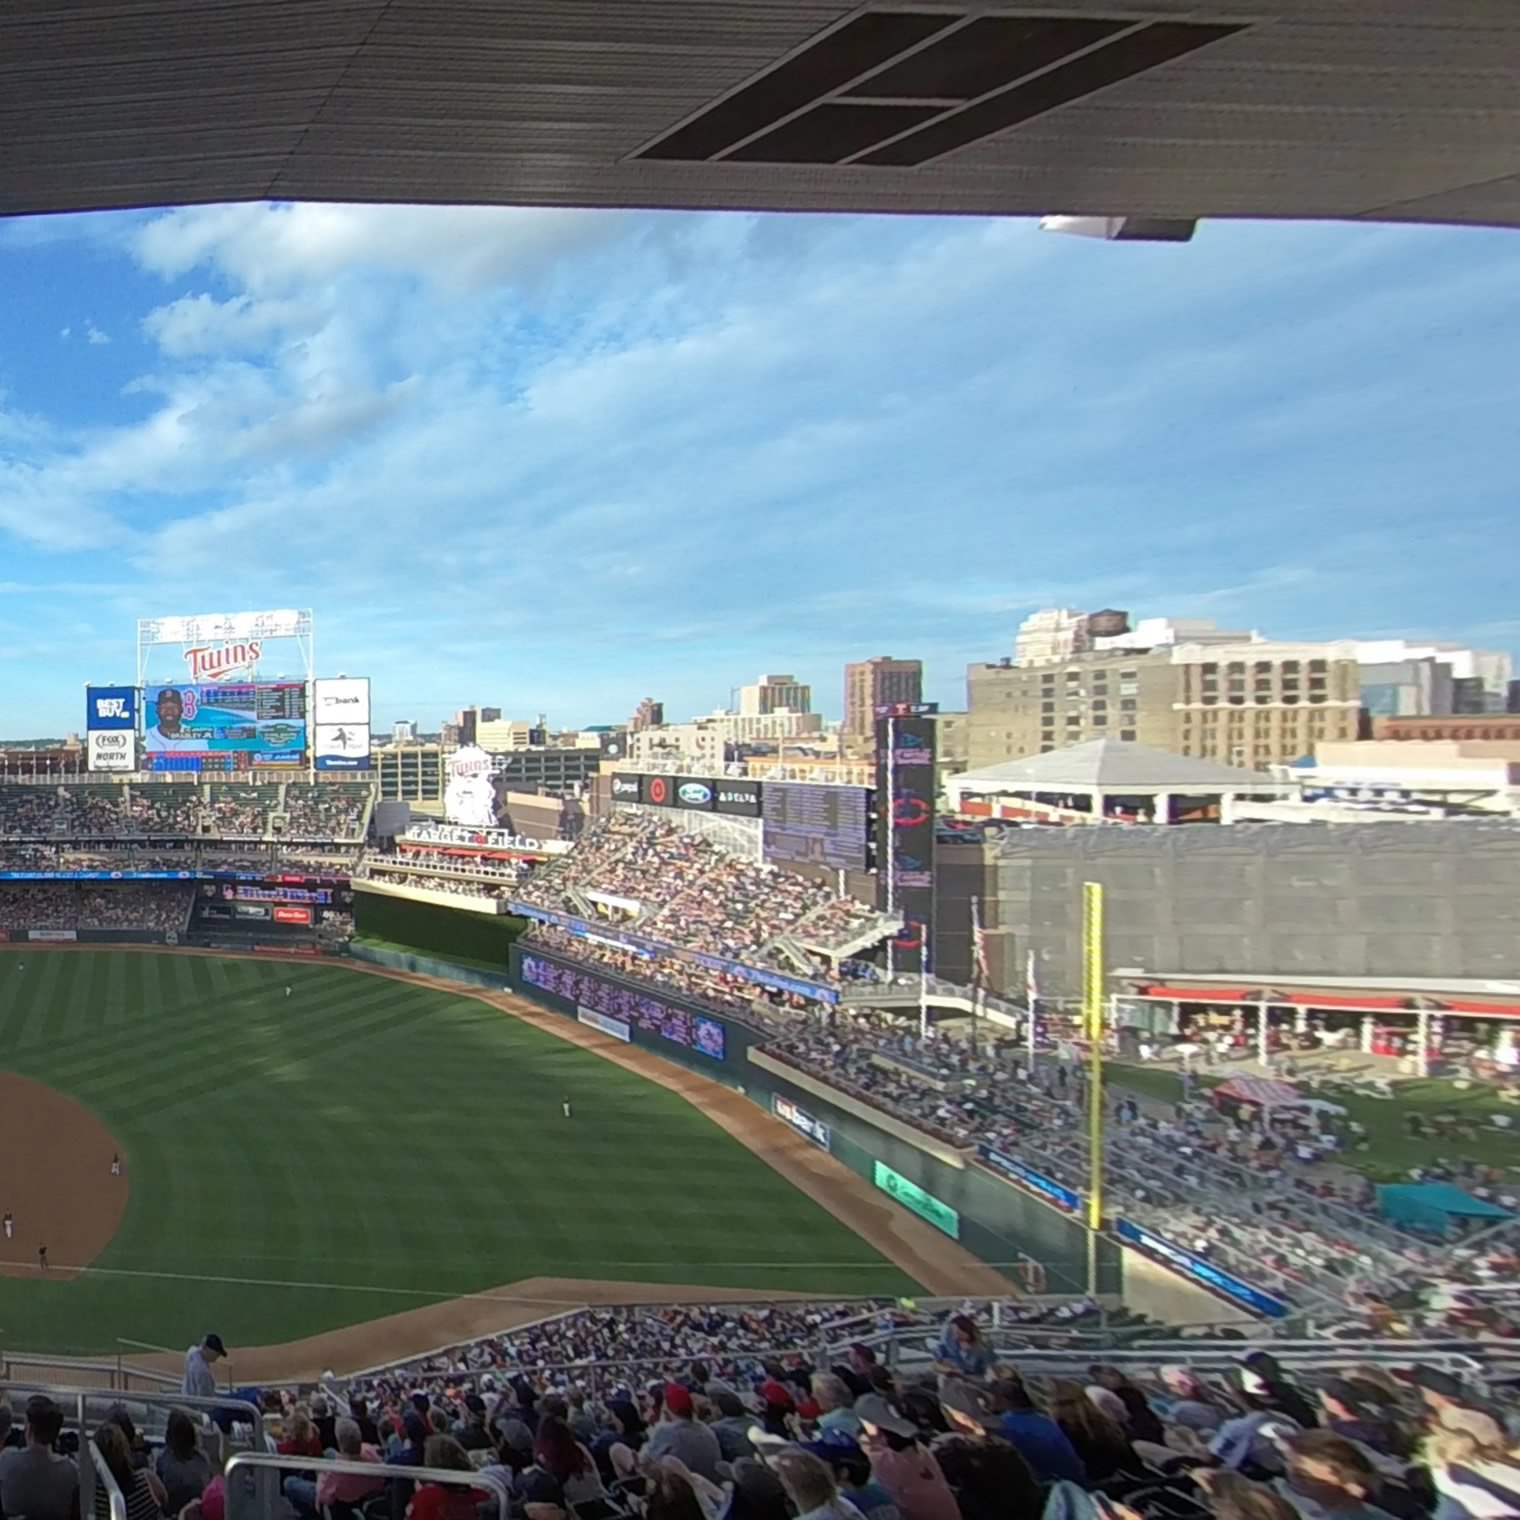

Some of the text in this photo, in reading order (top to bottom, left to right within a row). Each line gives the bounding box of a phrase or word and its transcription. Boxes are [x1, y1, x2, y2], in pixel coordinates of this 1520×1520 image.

[184, 640, 260, 679] Twins
[96, 698, 126, 708] BEST
[98, 707, 122, 718] BUY
[102, 735, 120, 744] FOX
[96, 752, 127, 761] NORTH
[412, 827, 540, 850] TARGET FIELD
